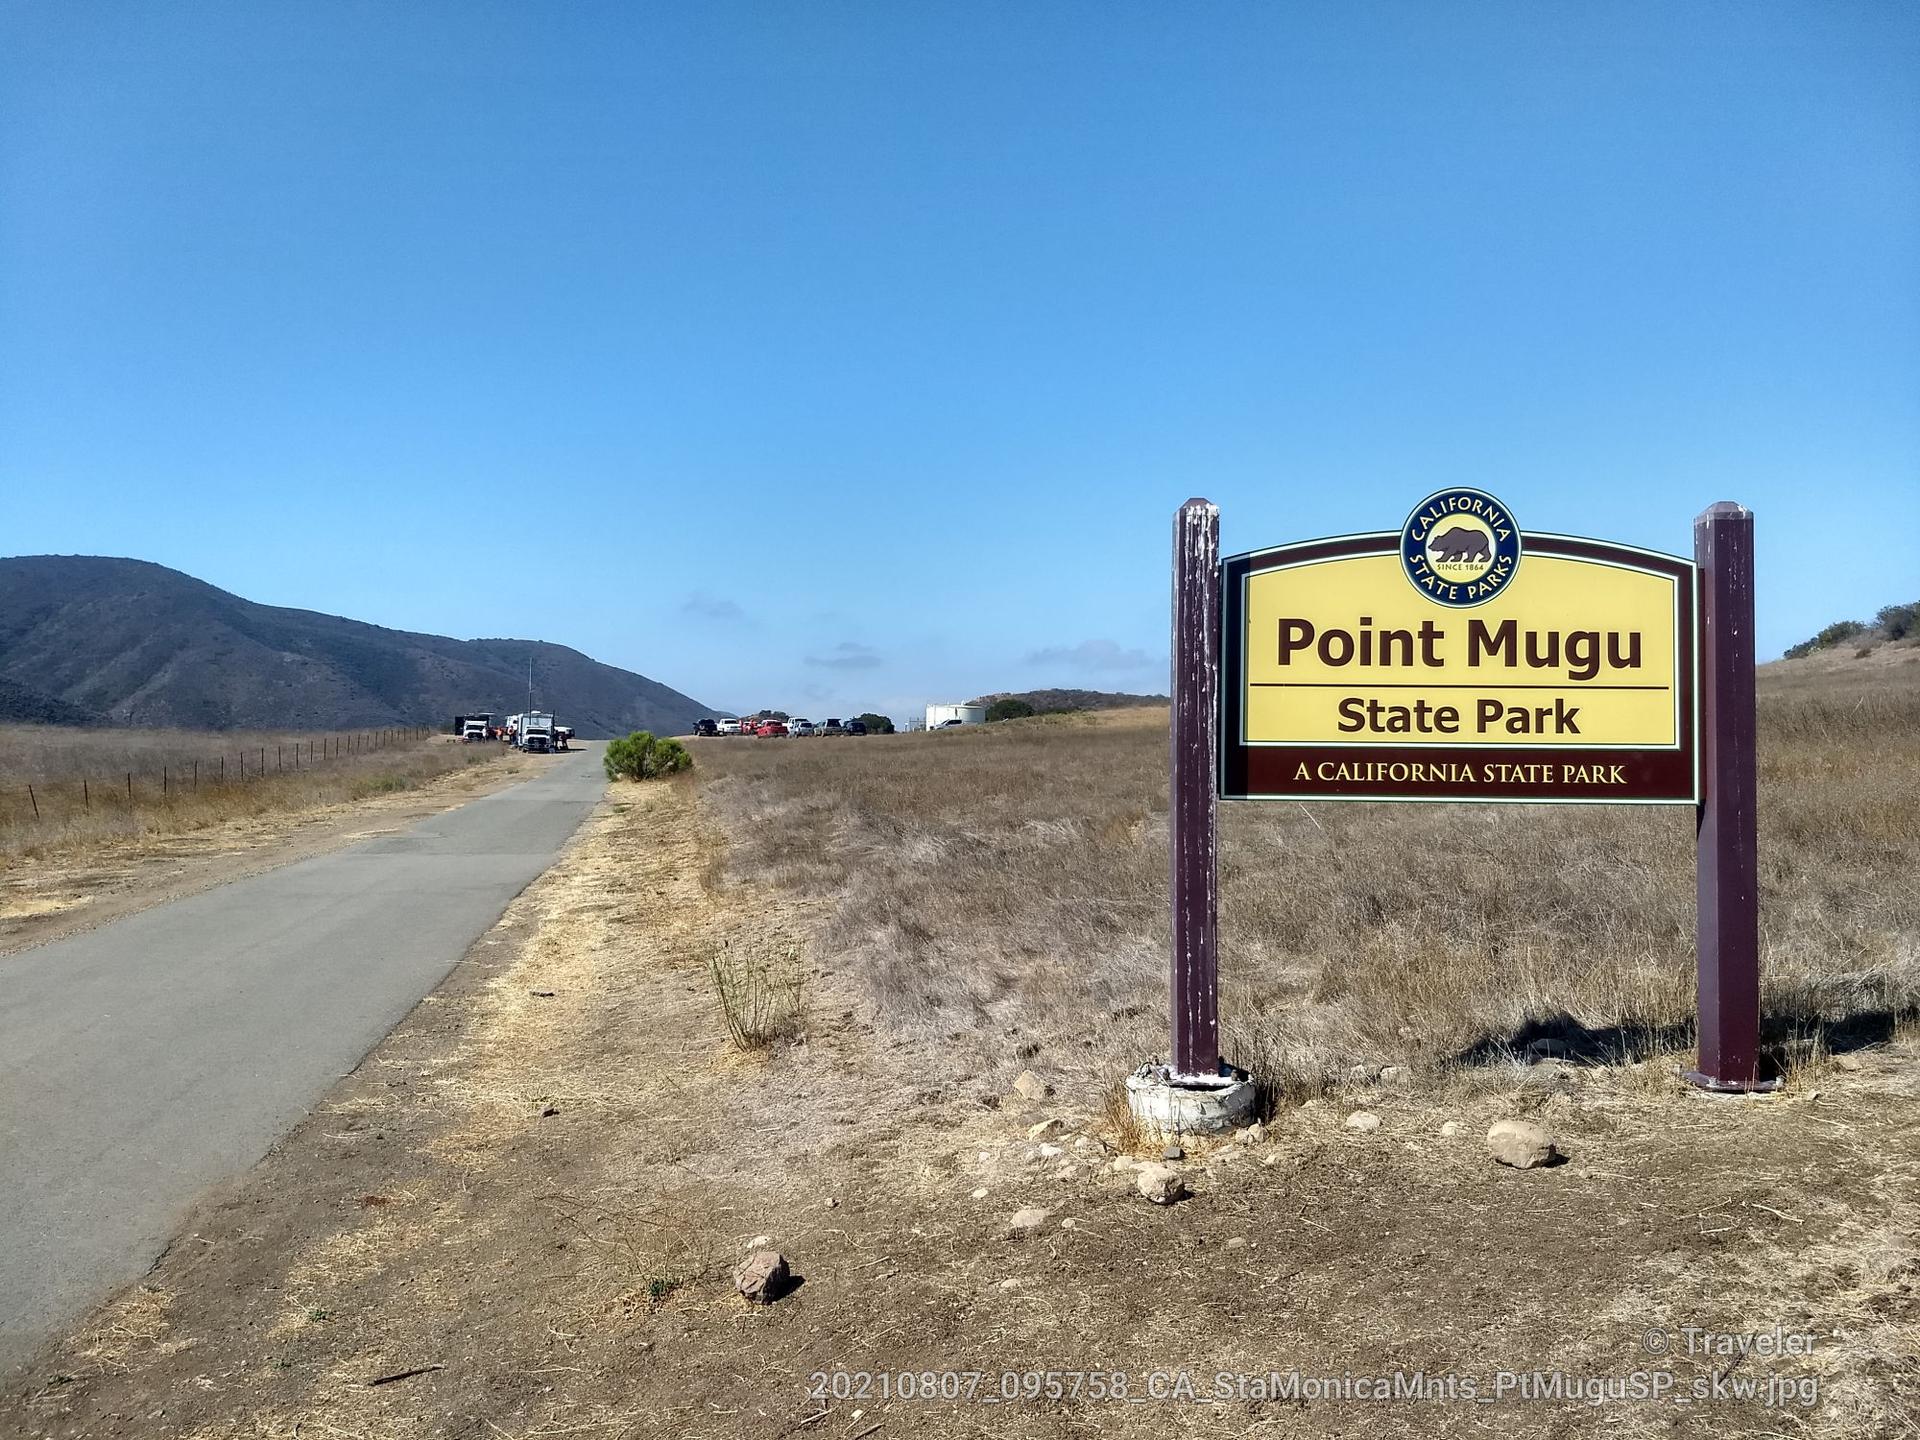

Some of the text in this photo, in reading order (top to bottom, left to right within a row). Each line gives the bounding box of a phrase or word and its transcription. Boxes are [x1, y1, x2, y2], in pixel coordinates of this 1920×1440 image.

[1411, 496, 1511, 541] CALIFORNIA
[1409, 554, 1512, 600] STATE PARKS
[1437, 563, 1484, 571] SINCE 1864
[1278, 617, 1642, 681] Point Mugu
[1337, 698, 1581, 735] State Park
[1294, 762, 1628, 785] A CALIFORNIA STATE PARK
